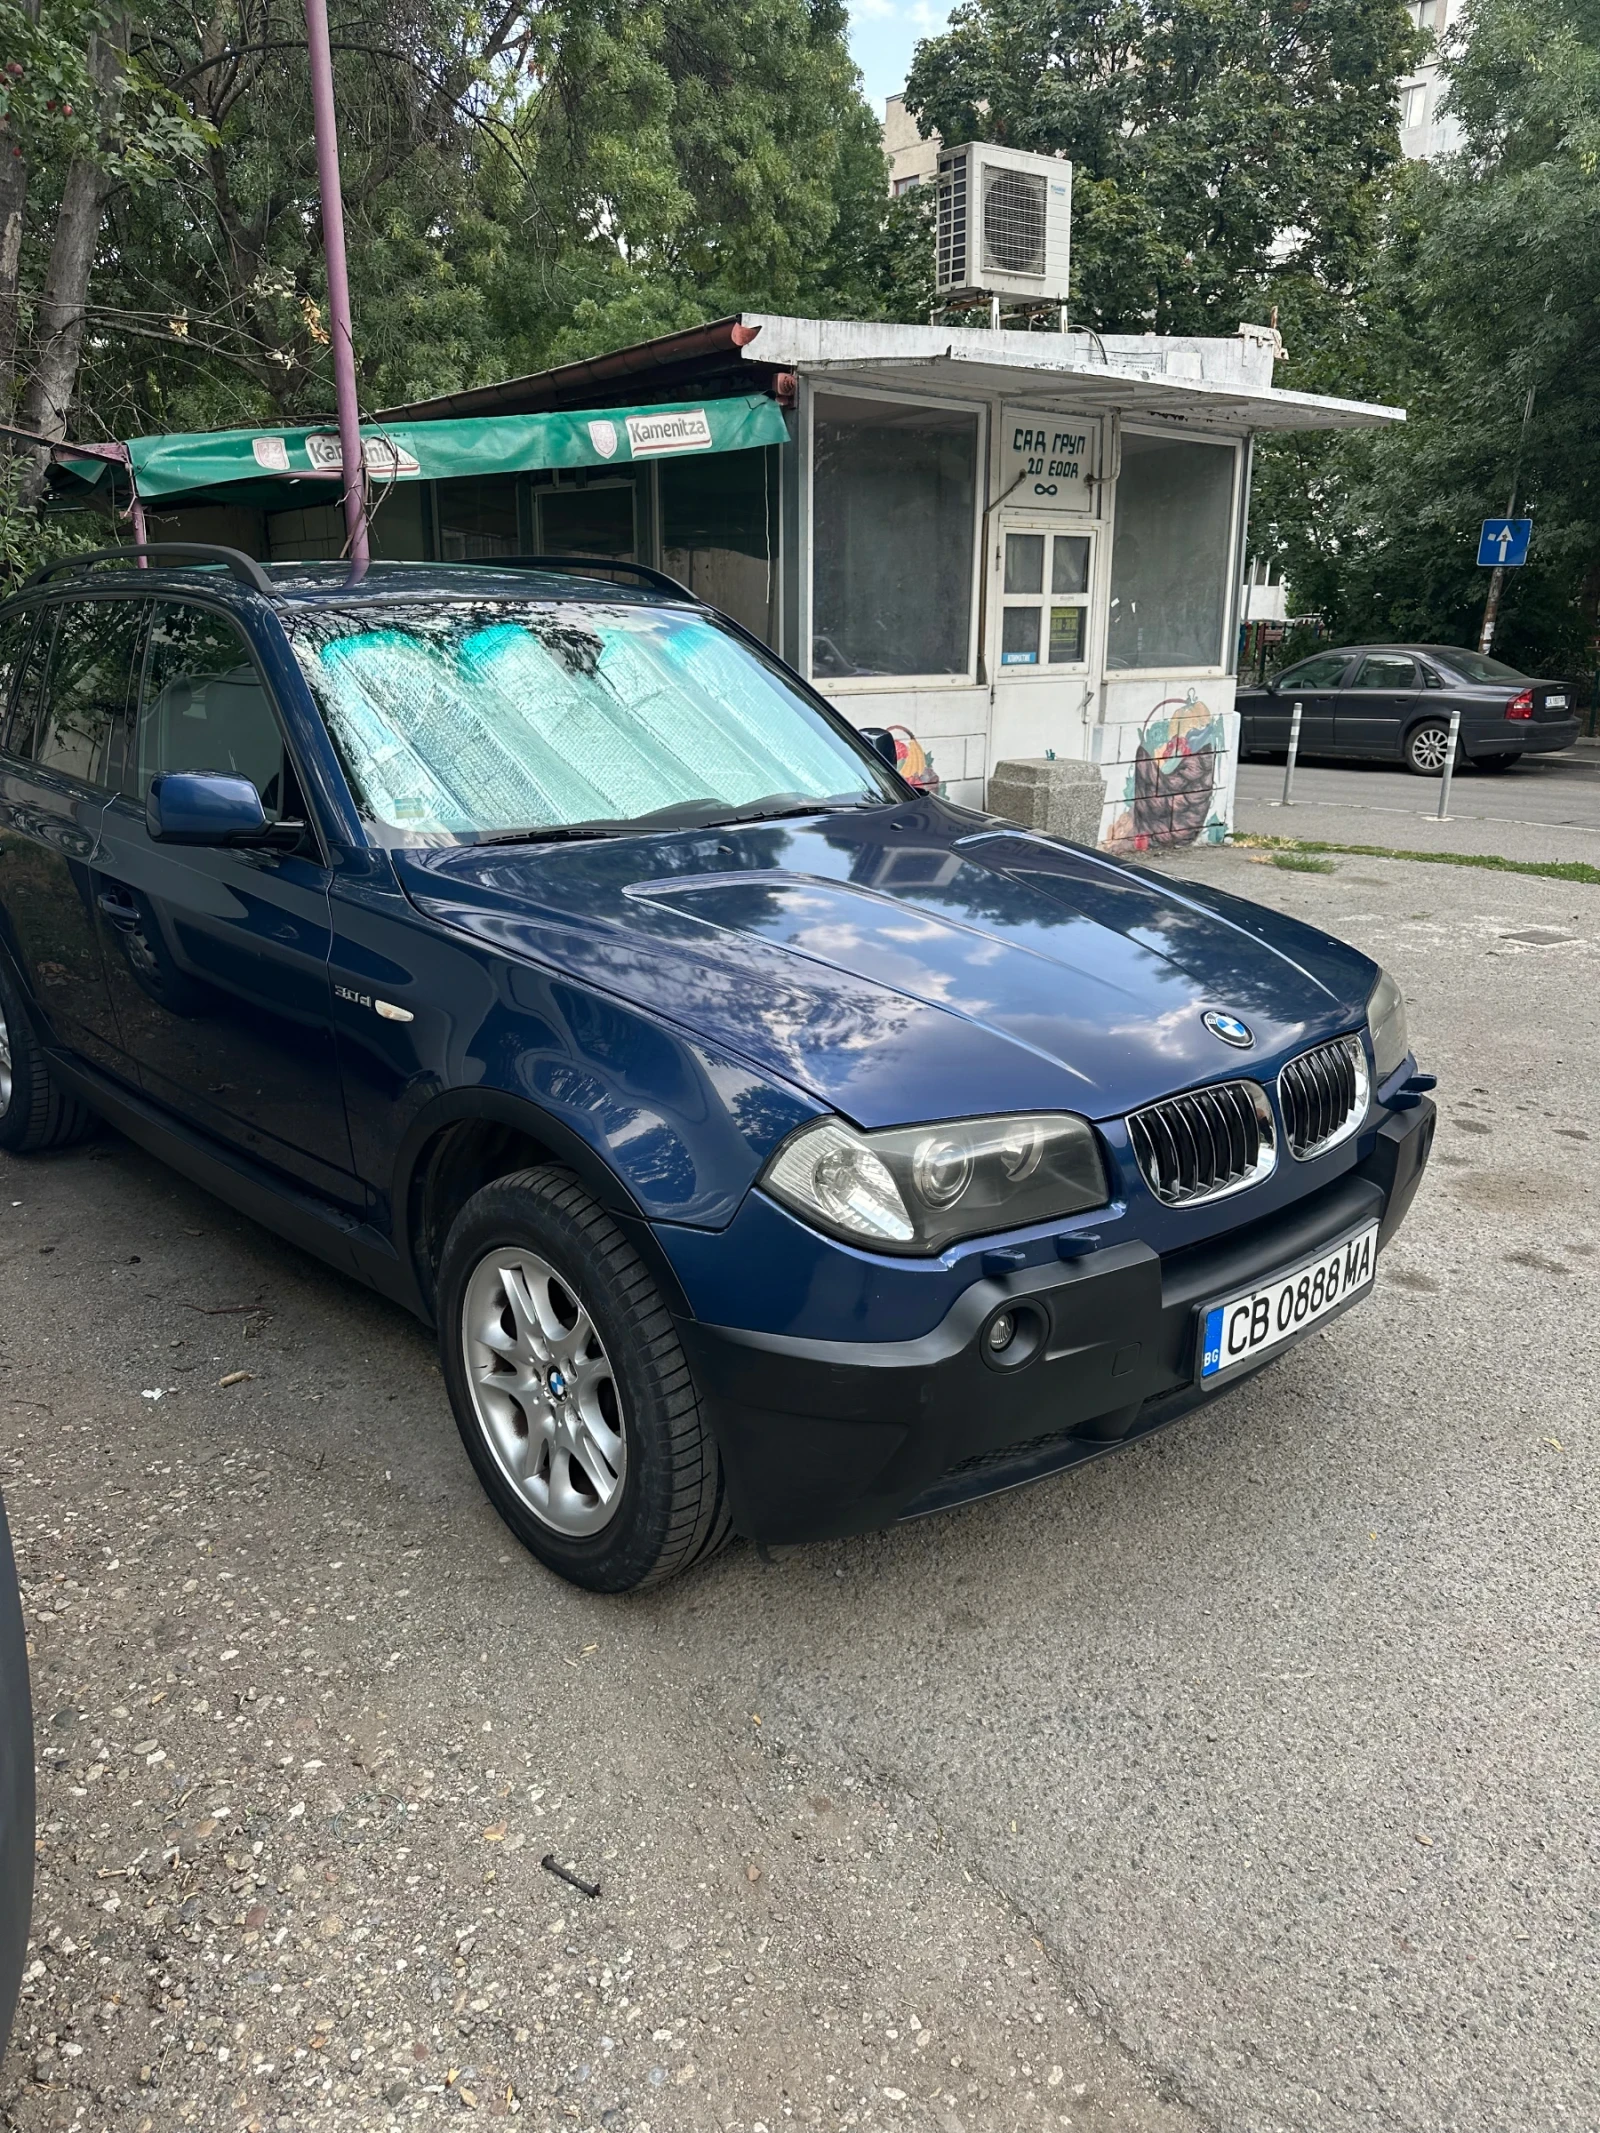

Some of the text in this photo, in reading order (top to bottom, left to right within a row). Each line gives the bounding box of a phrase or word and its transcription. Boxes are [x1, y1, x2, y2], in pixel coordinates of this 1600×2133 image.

[629, 418, 707, 443] Kamenitza
[1013, 428, 1086, 454] САД ГРУП
[1027, 457, 1043, 474] 20
[1228, 1235, 1371, 1355] CB 0888 MA
[1204, 1349, 1219, 1366] BG
